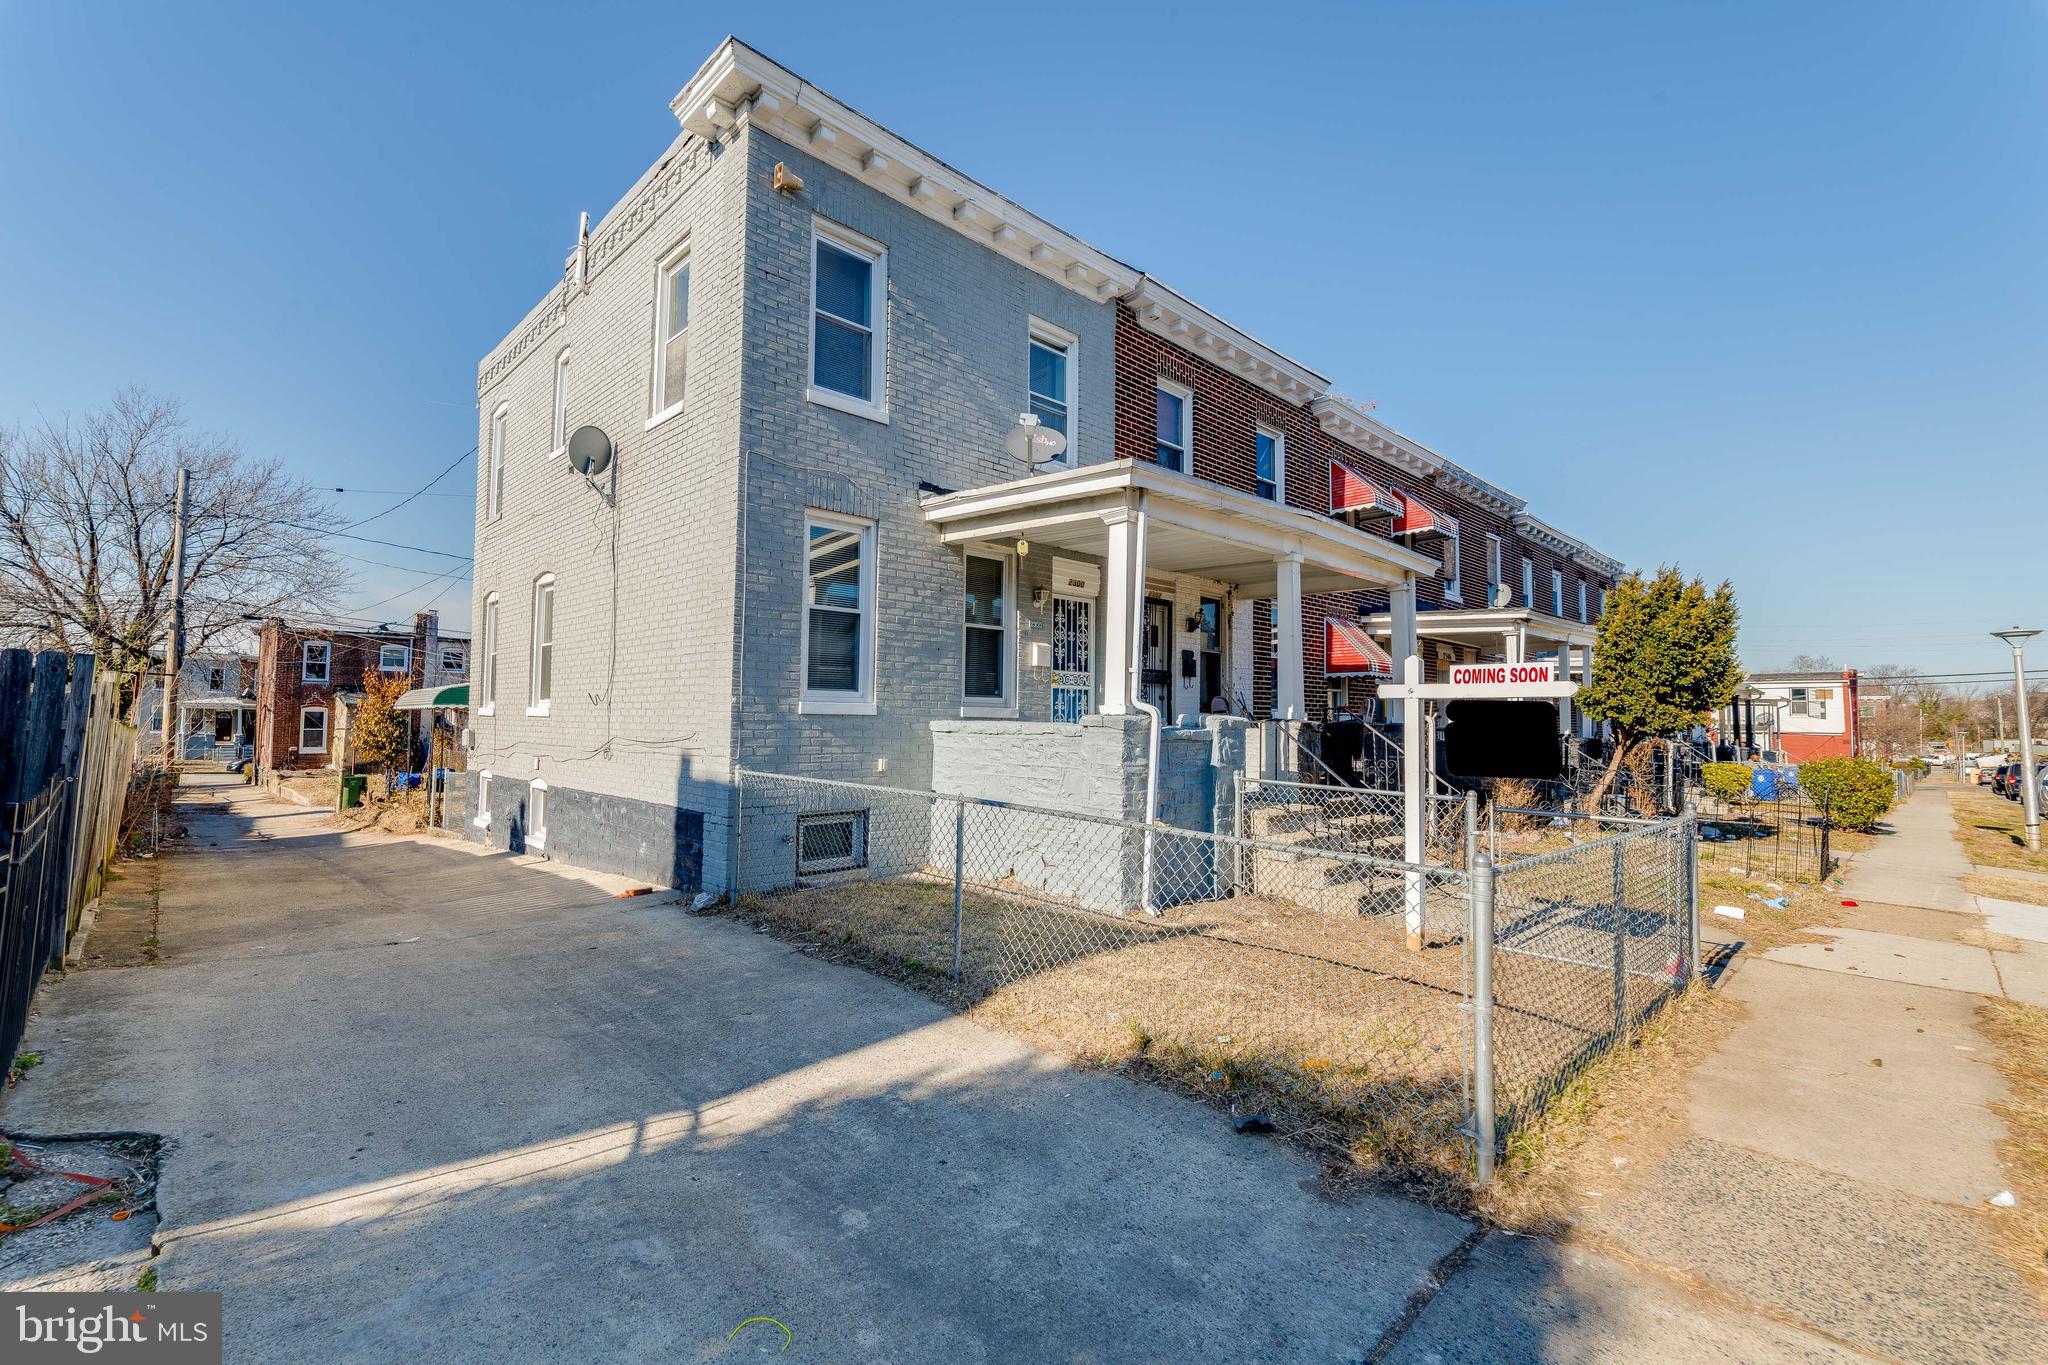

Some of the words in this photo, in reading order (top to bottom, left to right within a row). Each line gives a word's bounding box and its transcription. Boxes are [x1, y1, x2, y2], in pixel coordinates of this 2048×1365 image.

[1068, 579, 1085, 588] 2300
[1454, 668, 1506, 684] COMING
[1510, 667, 1549, 683] SOON
